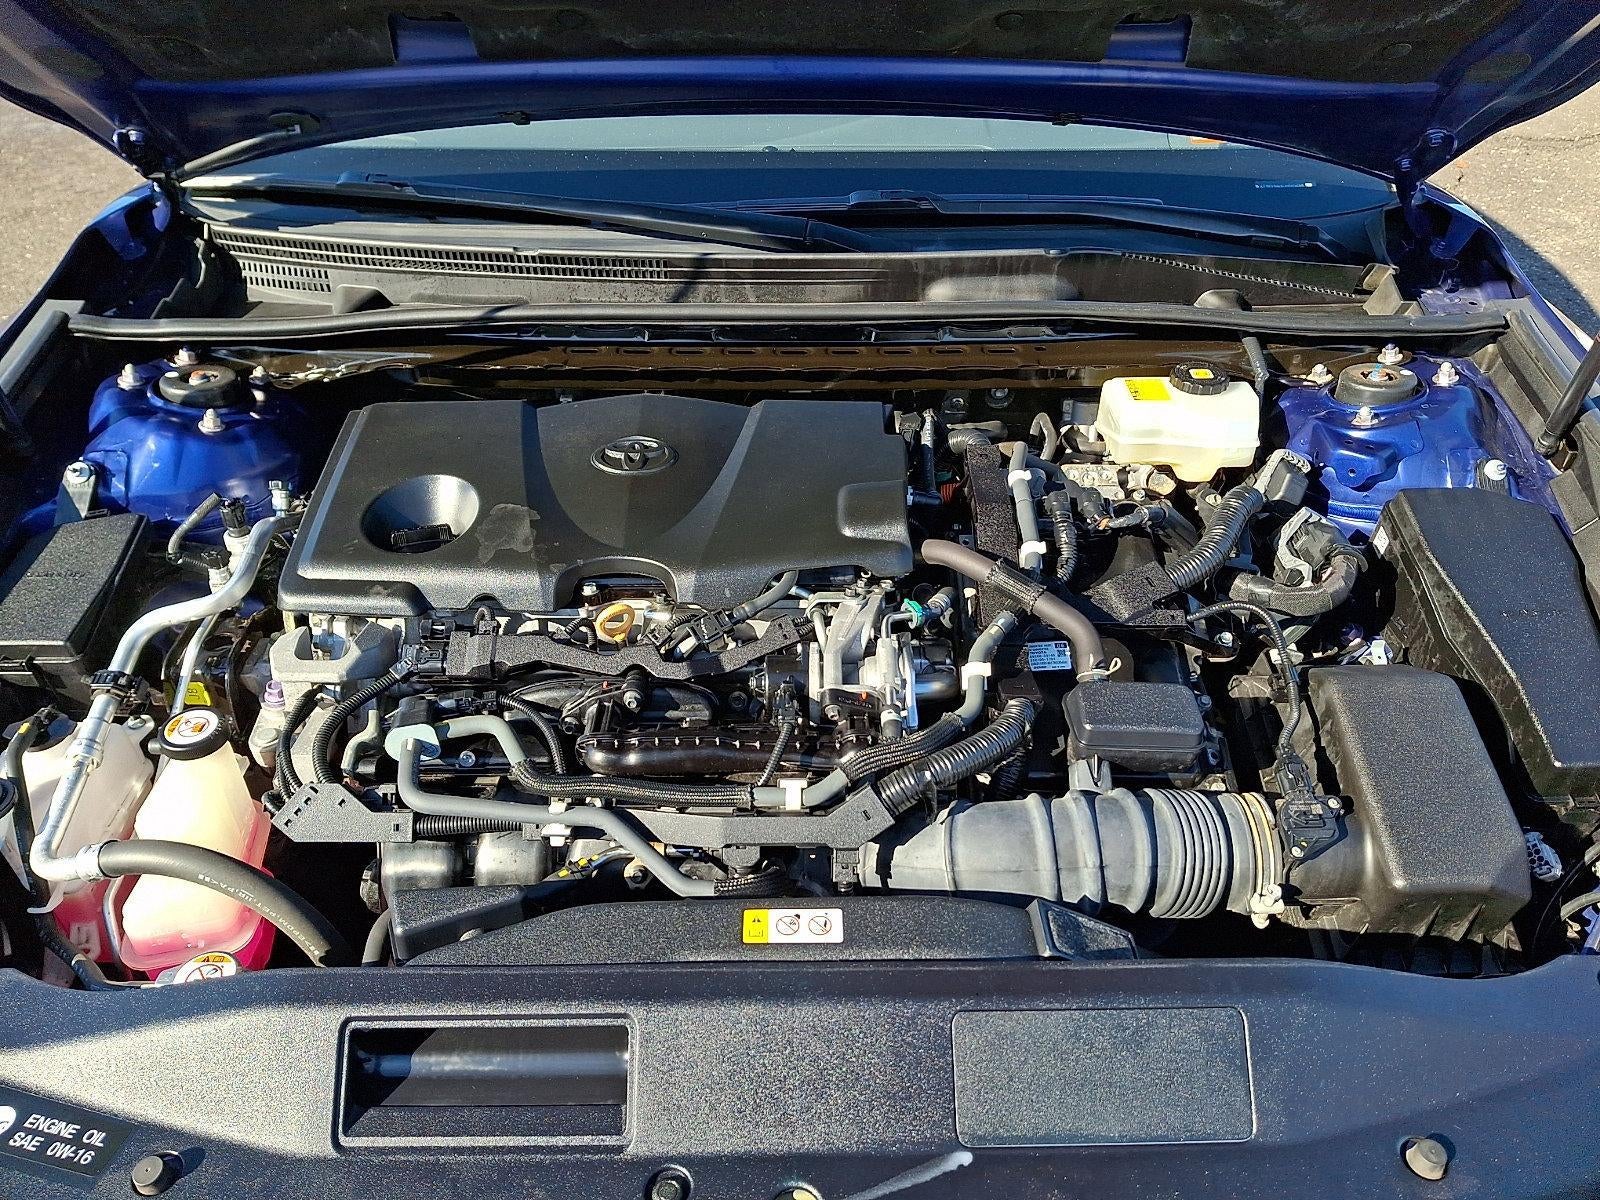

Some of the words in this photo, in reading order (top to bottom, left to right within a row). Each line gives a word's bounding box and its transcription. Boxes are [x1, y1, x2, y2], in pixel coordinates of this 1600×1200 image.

[8, 1131, 45, 1151] SAE
[23, 1113, 81, 1139] ENGINE
[82, 1129, 107, 1147] OIL
